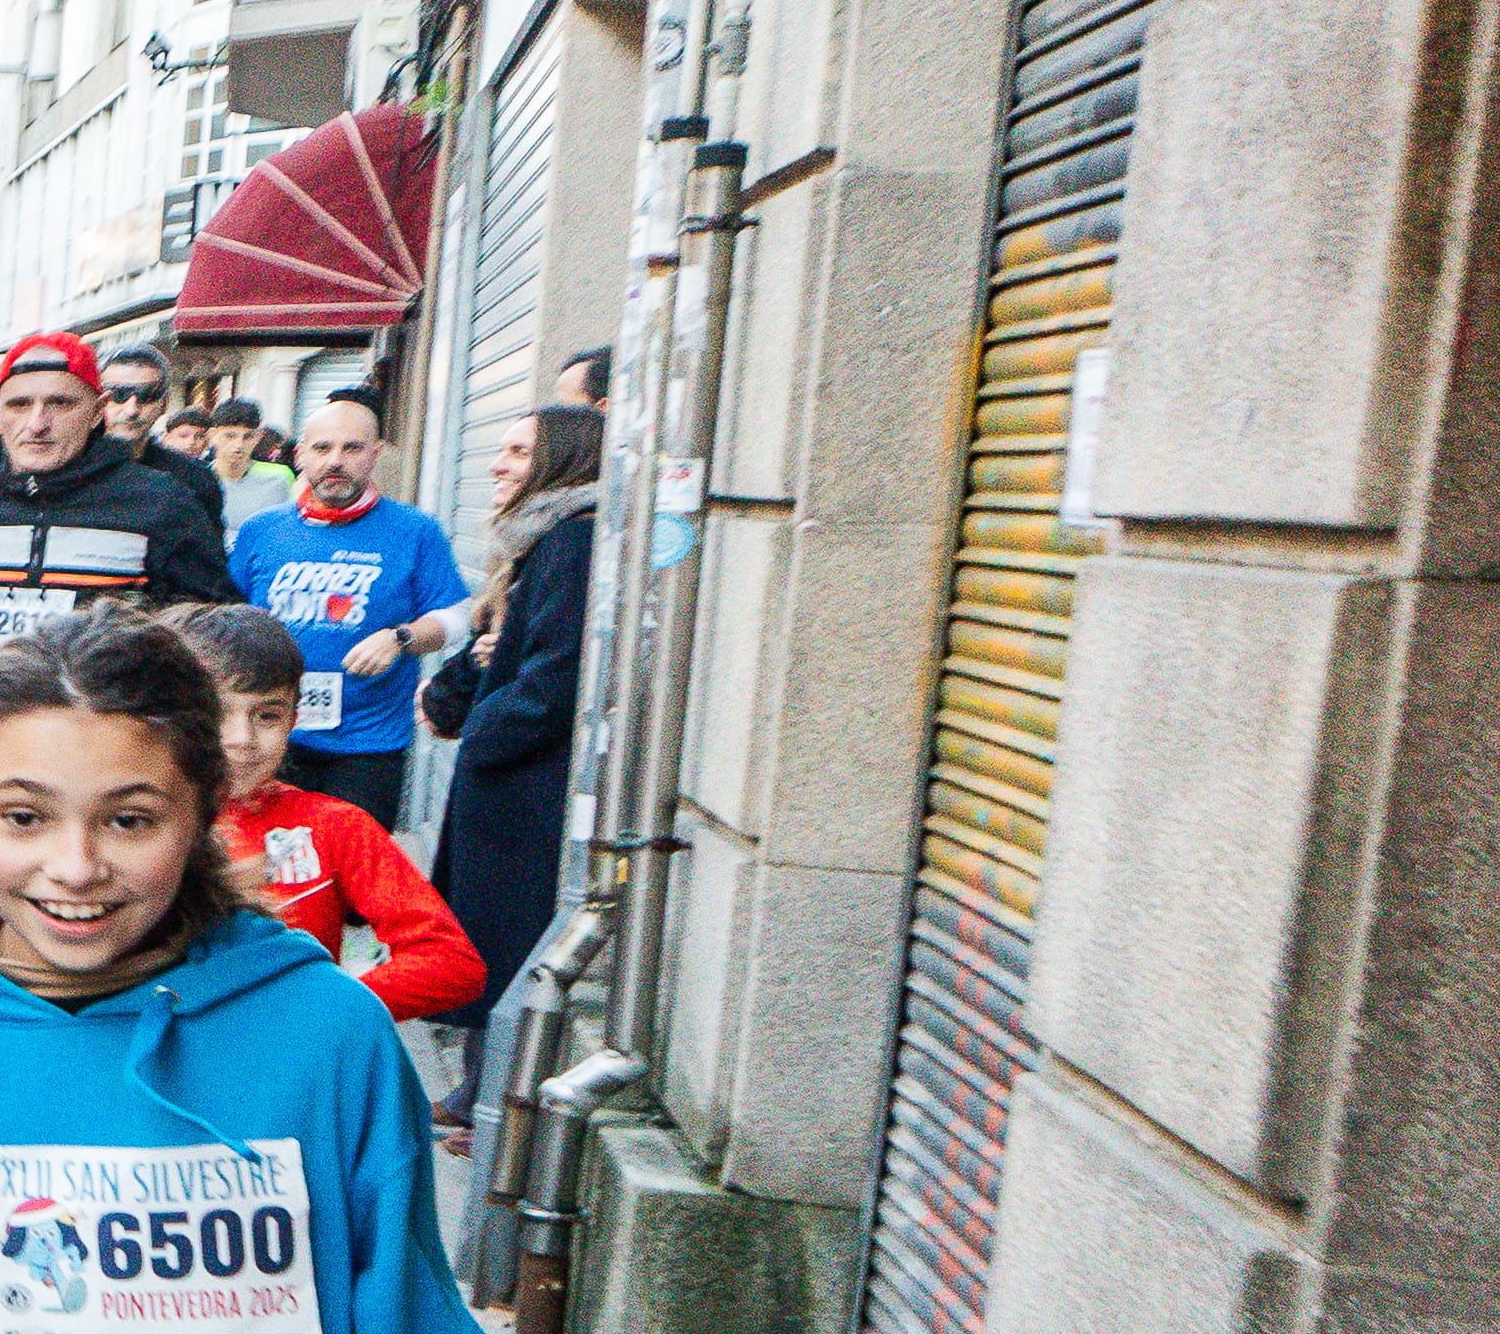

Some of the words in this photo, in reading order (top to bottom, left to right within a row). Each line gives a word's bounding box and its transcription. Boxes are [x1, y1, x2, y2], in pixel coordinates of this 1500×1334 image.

[62, 1156, 121, 1204] SAN
[133, 1151, 288, 1205] SILVESTRE
[98, 1205, 296, 1281] 6500
[101, 1288, 243, 1322] PONTEVEDRA
[248, 1284, 301, 1317] 2025
